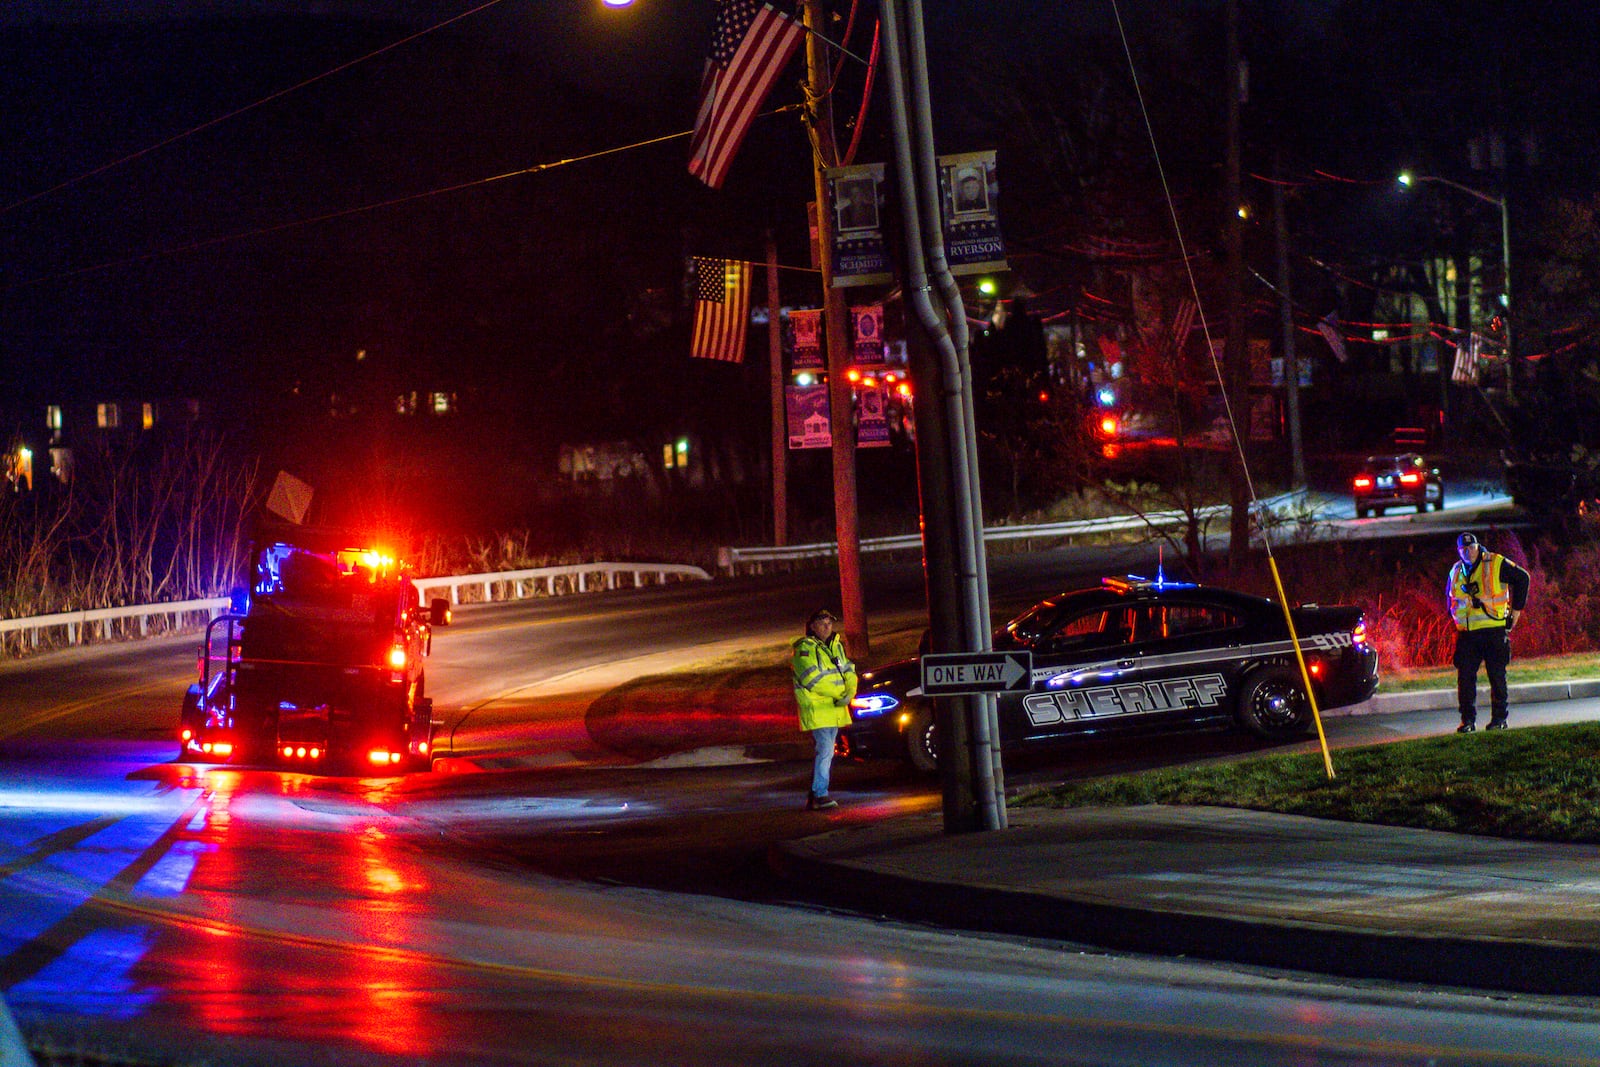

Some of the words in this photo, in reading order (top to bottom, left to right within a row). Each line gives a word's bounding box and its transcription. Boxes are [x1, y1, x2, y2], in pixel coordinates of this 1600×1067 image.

[950, 241, 1003, 257] RYERSON
[933, 667, 965, 683] ONE
[972, 664, 1004, 681] WAY
[1023, 673, 1228, 726] SHERIFF
